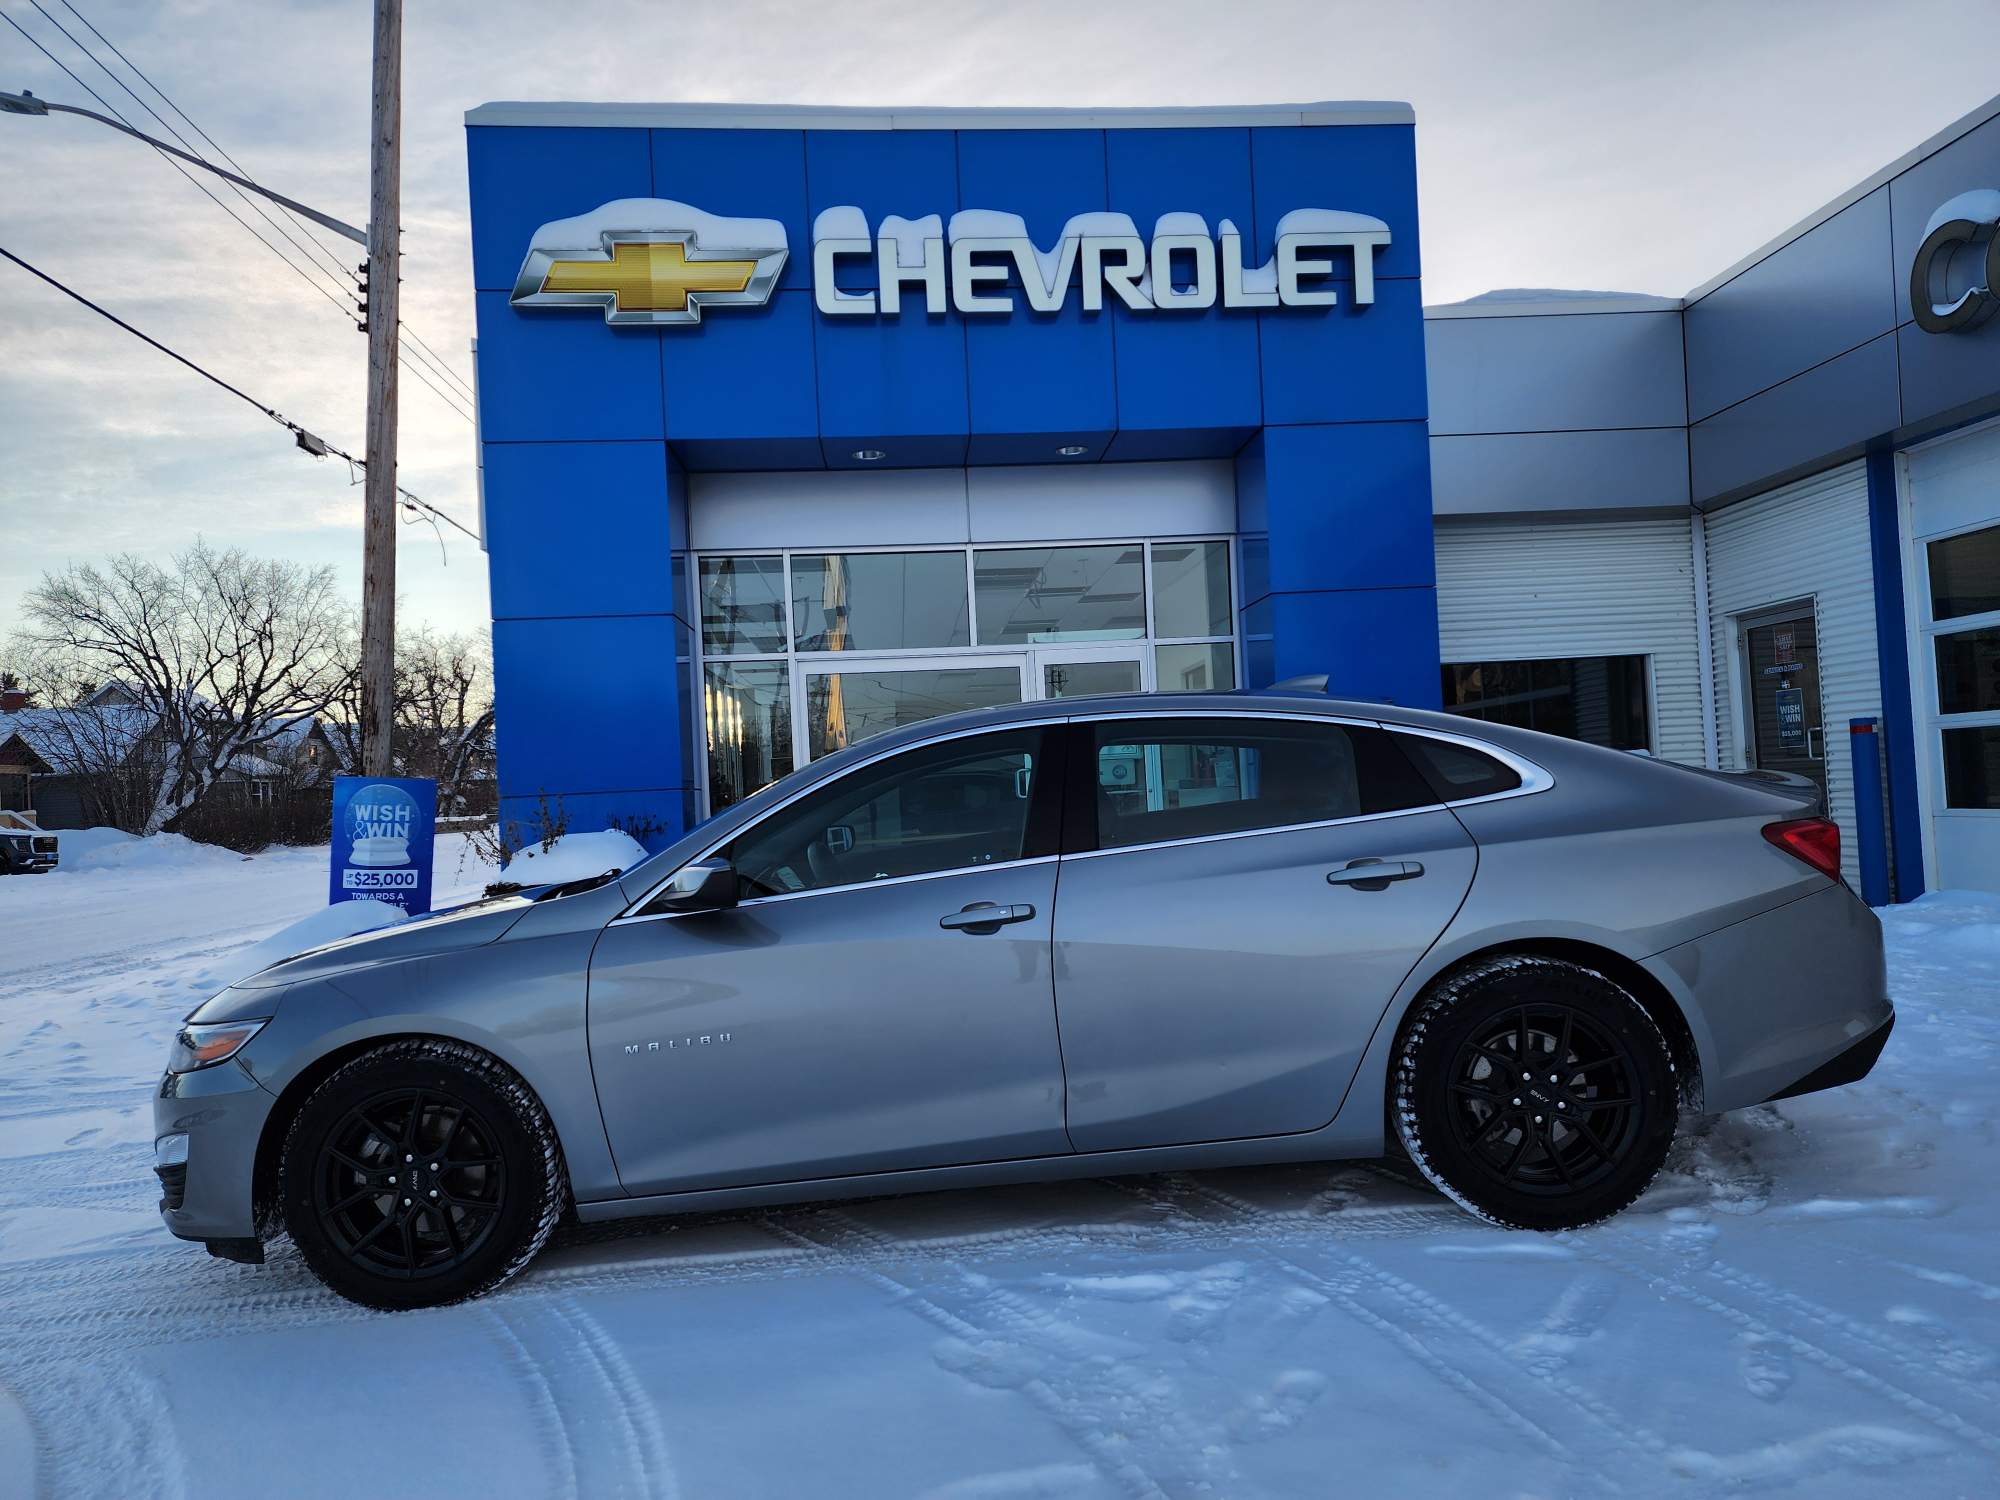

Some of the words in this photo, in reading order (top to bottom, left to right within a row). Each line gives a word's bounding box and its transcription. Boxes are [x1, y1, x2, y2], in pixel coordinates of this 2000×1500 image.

[814, 231, 1391, 314] CHEVROLET
[1780, 704, 1800, 714] WISH
[1785, 714, 1801, 722] WIN
[355, 805, 410, 821] WISH
[353, 821, 367, 840] &
[367, 823, 409, 839] WIN
[355, 872, 414, 887] $25,000
[352, 892, 395, 900] TOWARDS
[624, 1033, 731, 1055] MALIBU
